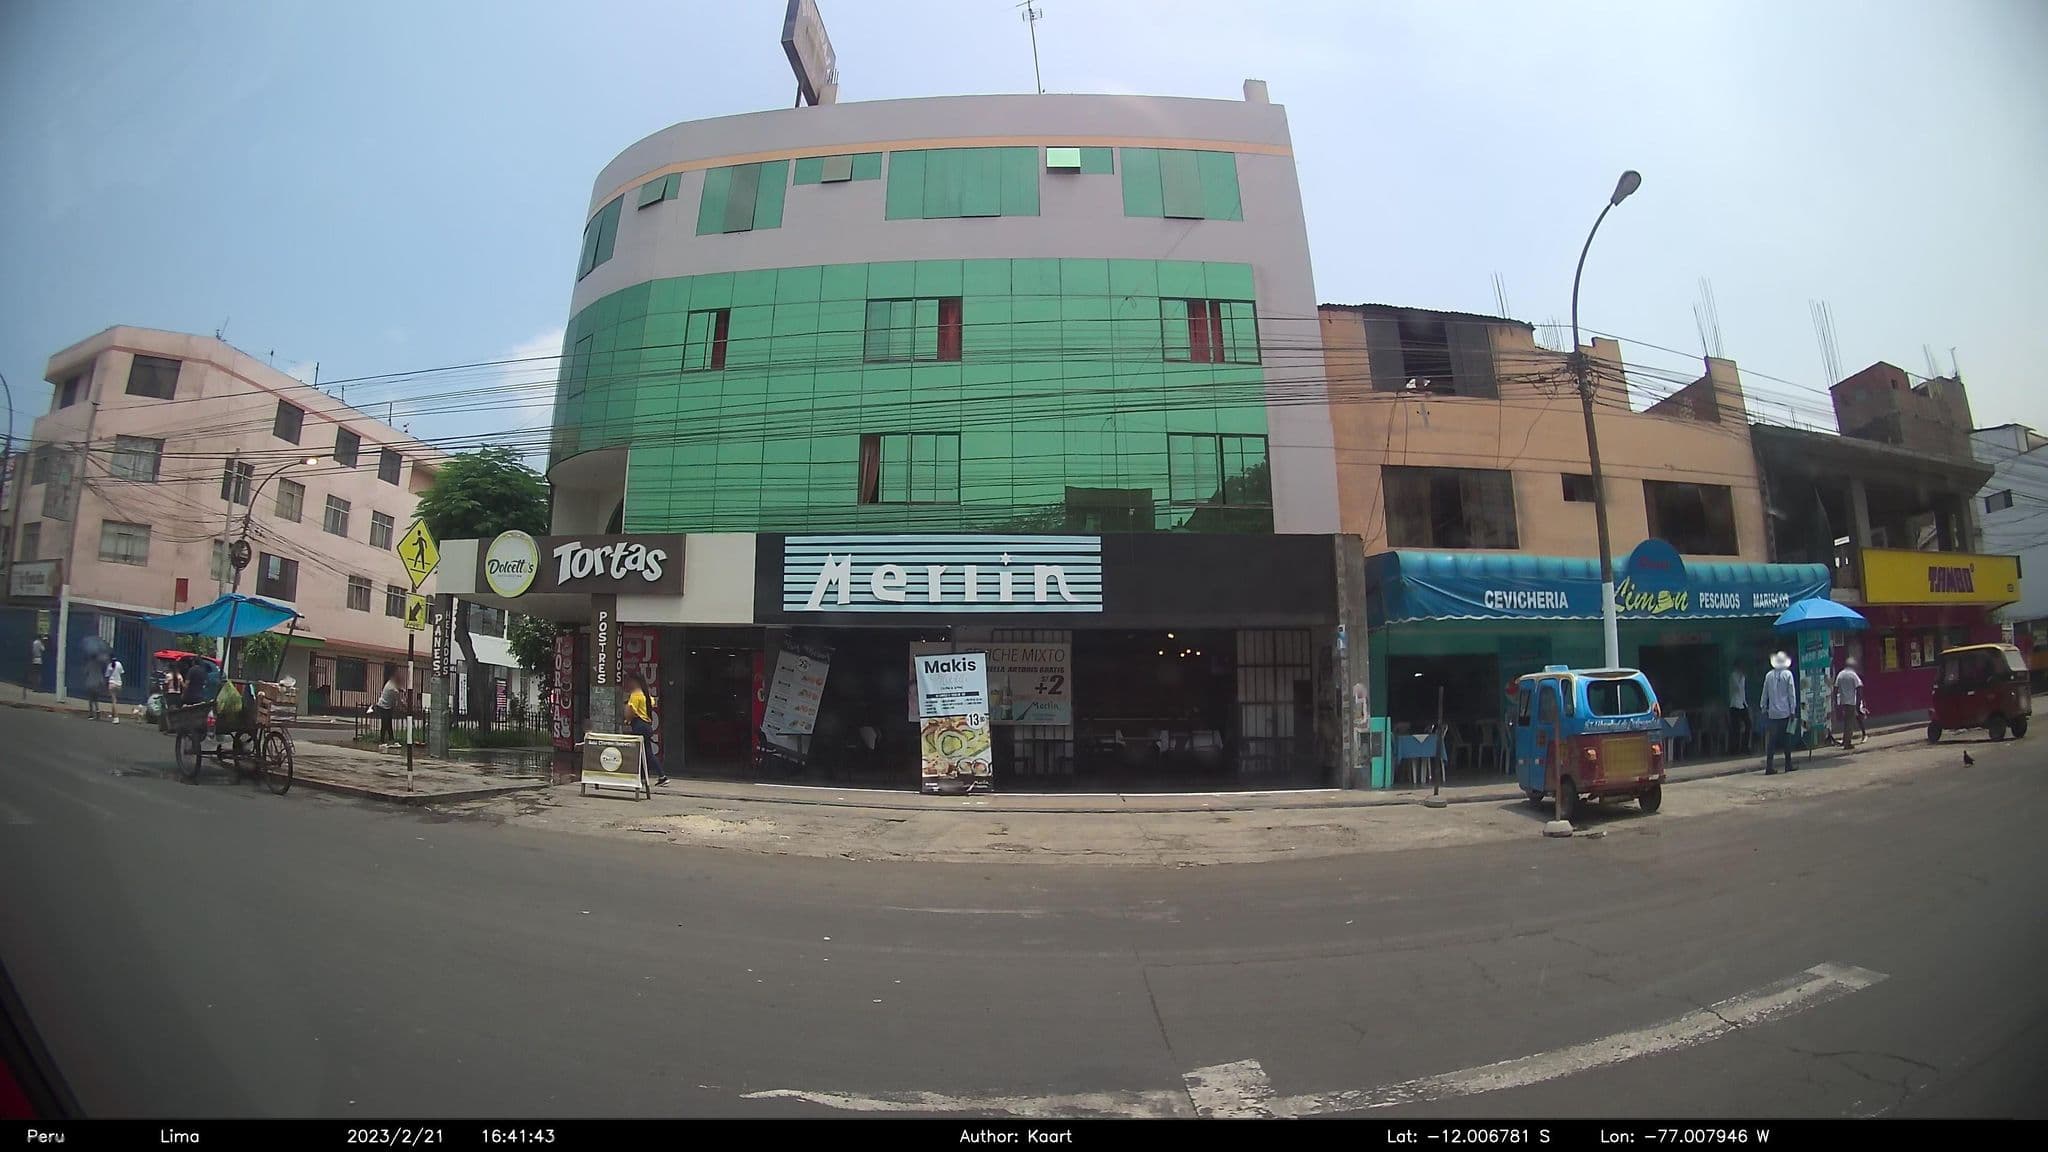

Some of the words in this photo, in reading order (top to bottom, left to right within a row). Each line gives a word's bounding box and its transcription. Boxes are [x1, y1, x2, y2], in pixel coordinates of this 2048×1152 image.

[553, 541, 668, 586] Tortas
[802, 551, 1082, 611] Merlin
[1483, 589, 1569, 610] CEVICHERIA
[1698, 592, 1741, 609] PESCADOS
[1752, 592, 1790, 609] MARISCOS
[432, 613, 443, 671] PANES
[442, 610, 451, 676] HELADOS
[597, 611, 608, 684] POSTRES
[615, 622, 623, 683] JUGOS
[924, 657, 977, 674] Makis
[1021, 648, 1066, 663] MIXTO
[553, 636, 563, 739] TORTAS
